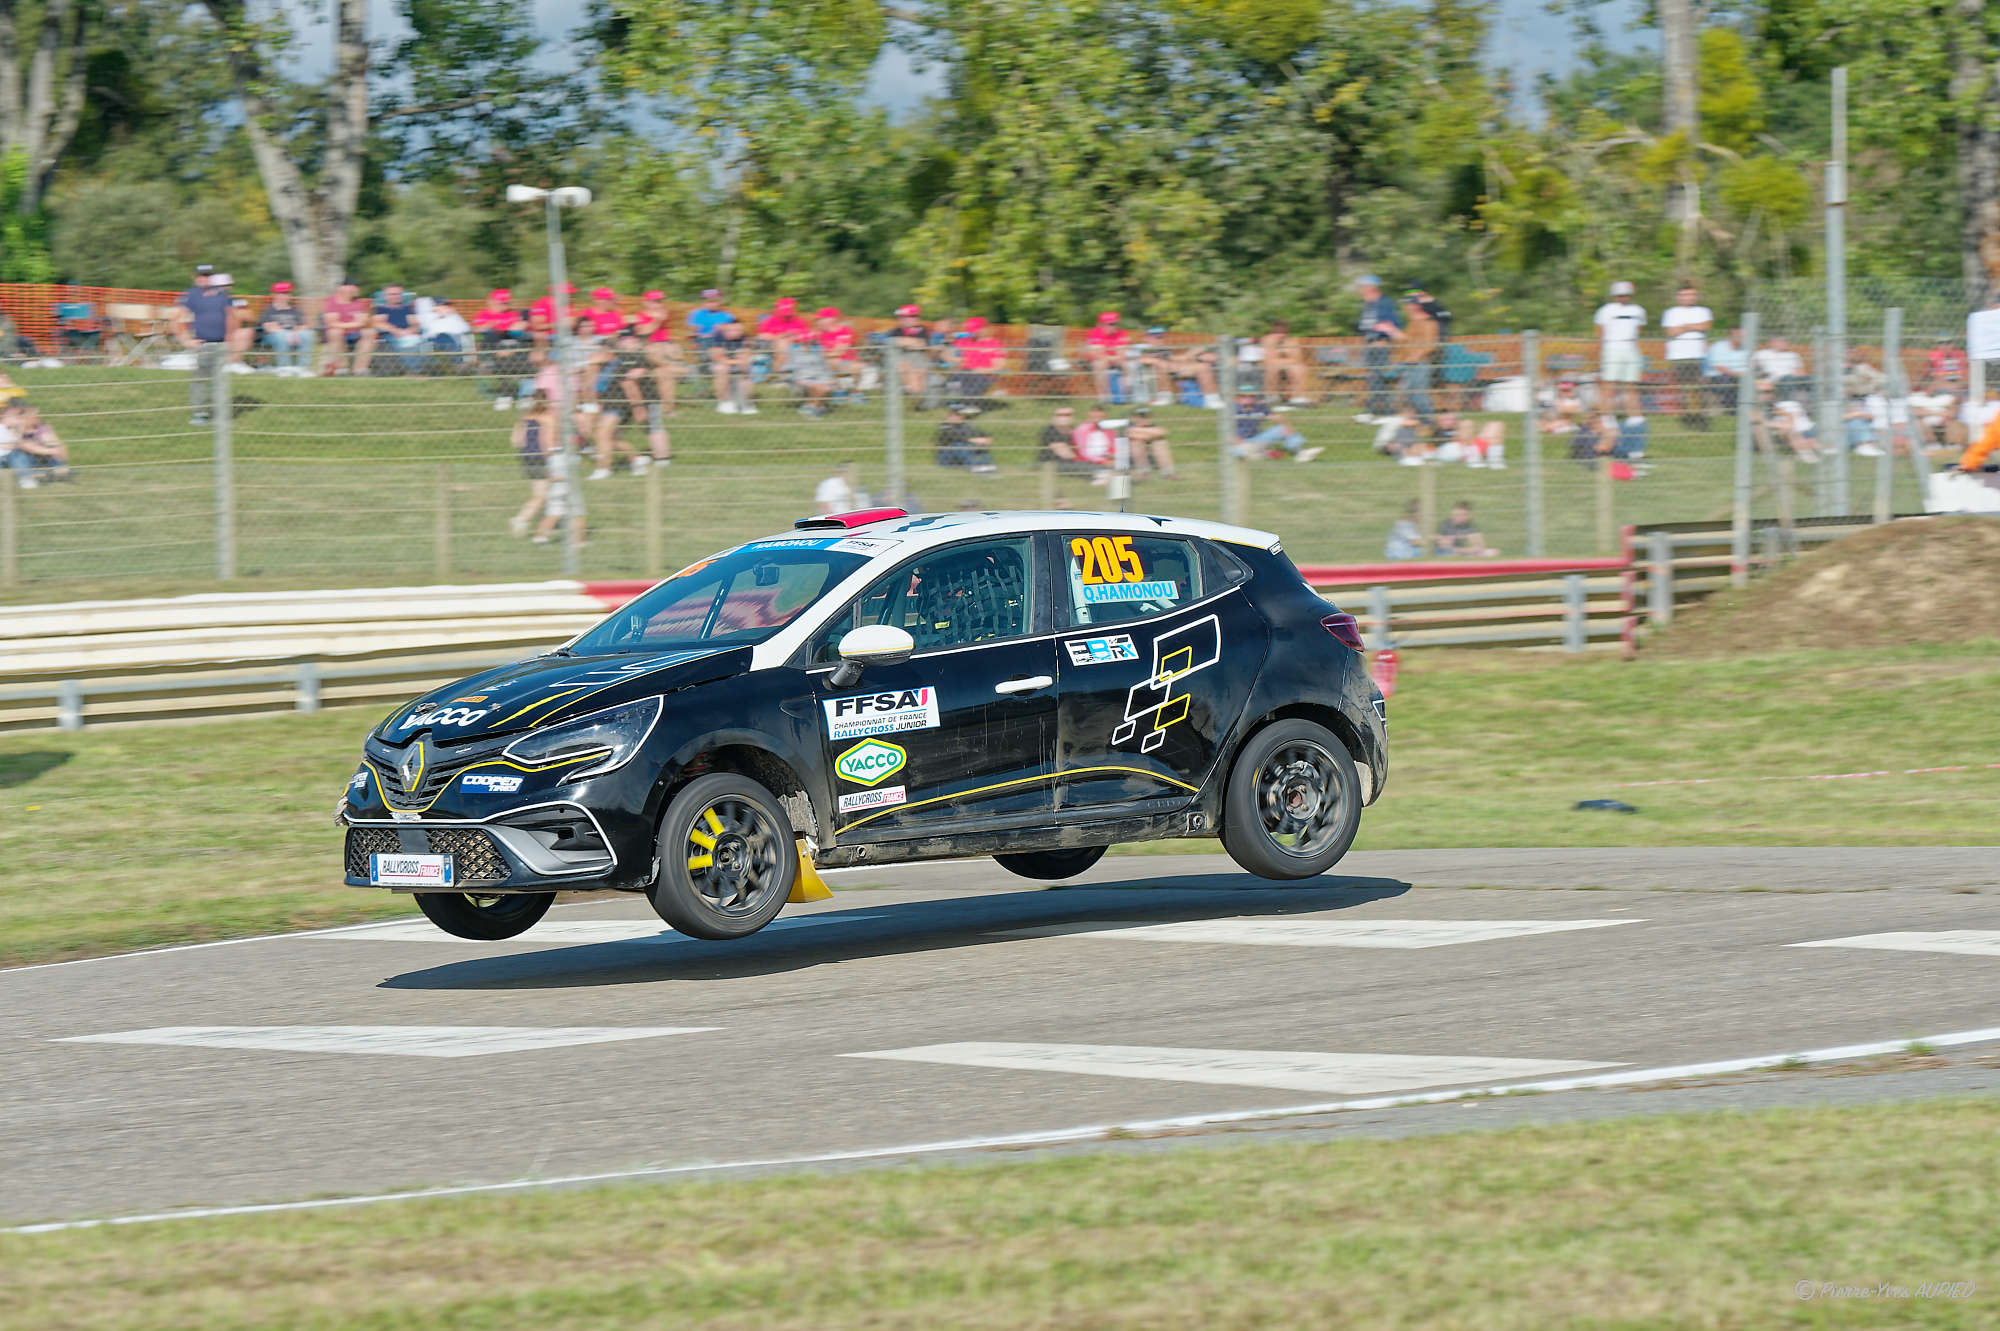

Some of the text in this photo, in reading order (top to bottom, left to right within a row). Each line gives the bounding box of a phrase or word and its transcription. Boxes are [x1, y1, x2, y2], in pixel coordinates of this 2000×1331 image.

[1071, 536, 1144, 585] 205
[1083, 582, 1173, 602] Q.HAMONOU
[836, 690, 919, 717] FFSA
[398, 707, 488, 730] YACCO
[834, 712, 927, 730] CHAMPIONNAT DE FRANCE
[834, 719, 927, 738] RALLYCROSS JUNIOR
[845, 752, 898, 772] YACCO
[462, 775, 523, 787] COOPER
[843, 791, 882, 808] RALLYCROSS
[383, 860, 420, 874] RALLYCROSS
